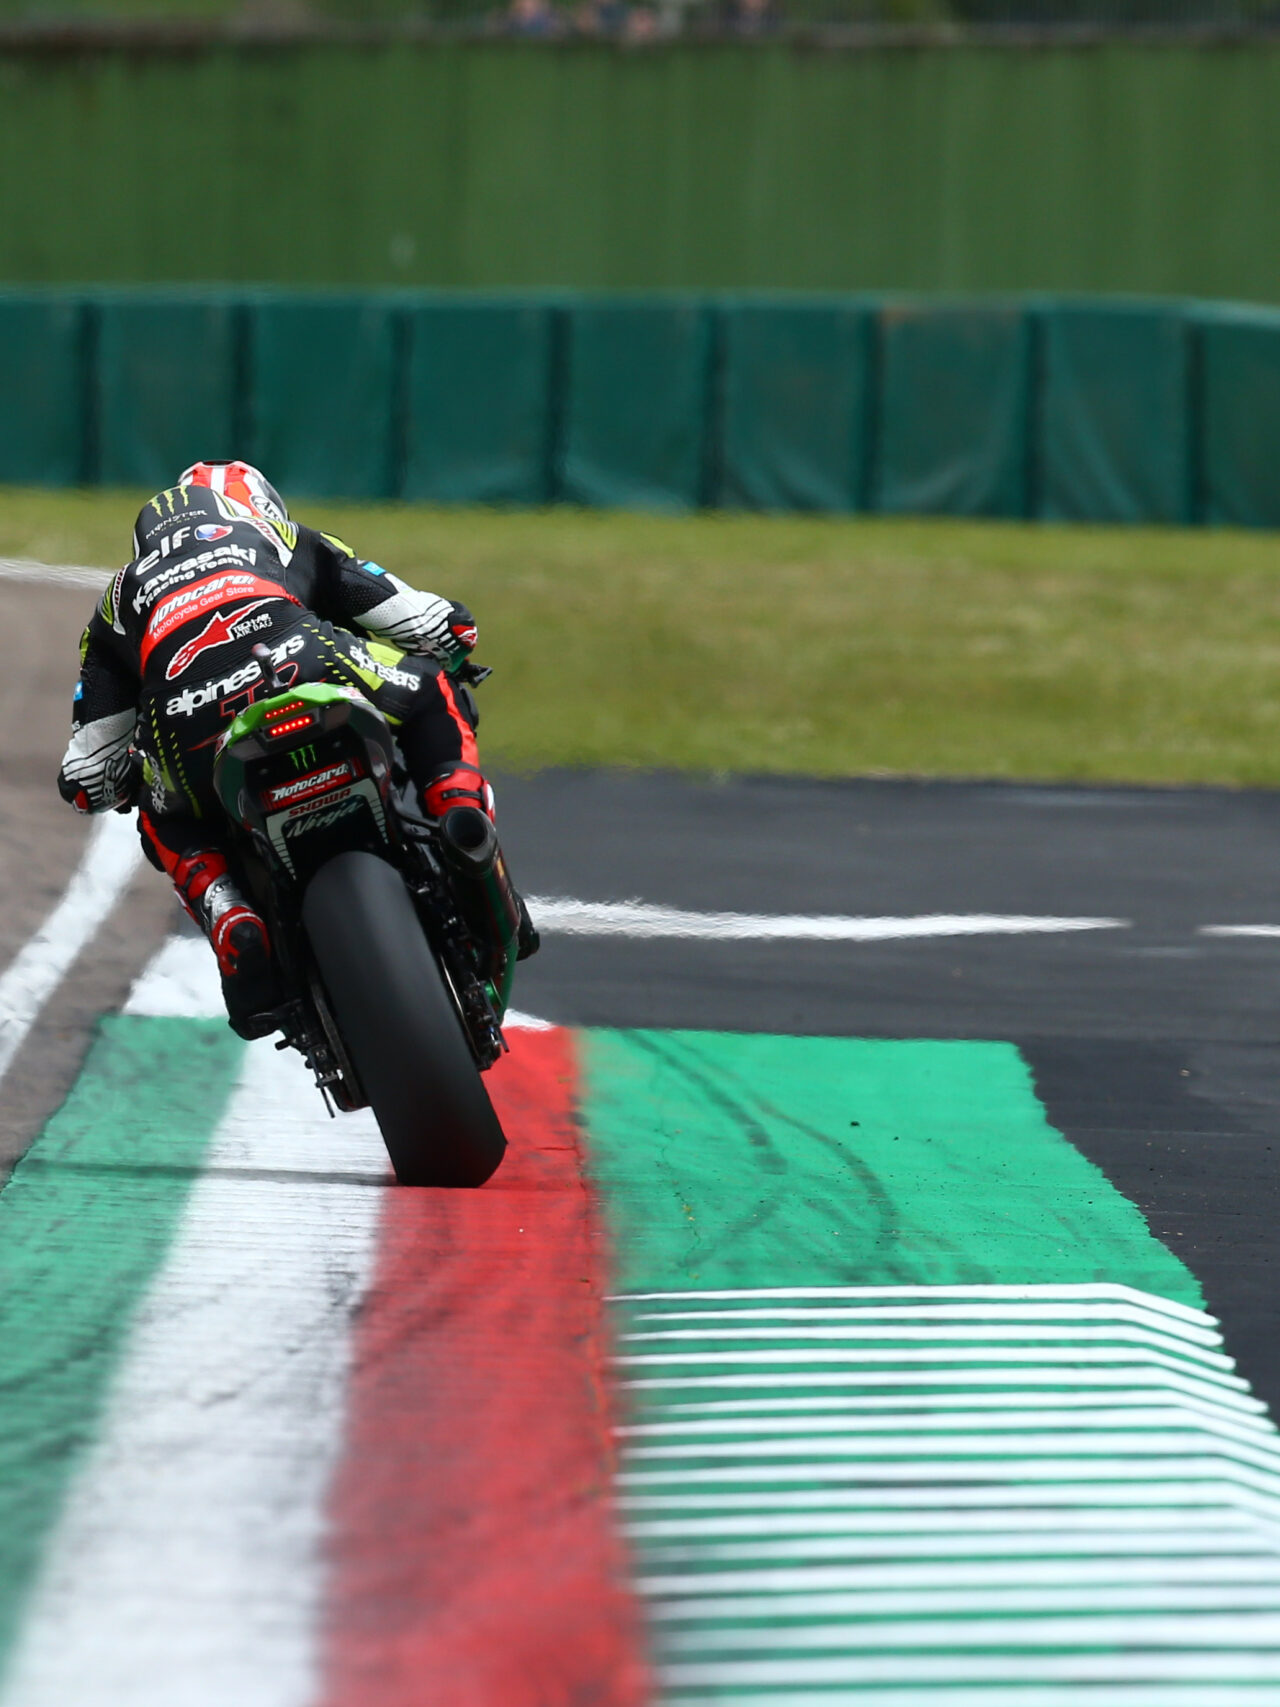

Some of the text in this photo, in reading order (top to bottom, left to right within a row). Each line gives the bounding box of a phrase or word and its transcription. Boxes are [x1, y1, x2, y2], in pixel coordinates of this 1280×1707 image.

[145, 509, 208, 540] MONSTER
[136, 526, 191, 576] elf
[132, 544, 257, 615] Kawasaki
[144, 570, 196, 607] Racing
[197, 557, 244, 573] Team
[152, 586, 254, 640] Motorcycle Gear Store
[235, 627, 253, 640] AIR
[166, 634, 305, 716] alpinesars
[286, 801, 365, 839] Ninja
[288, 787, 352, 818] SHOWA
